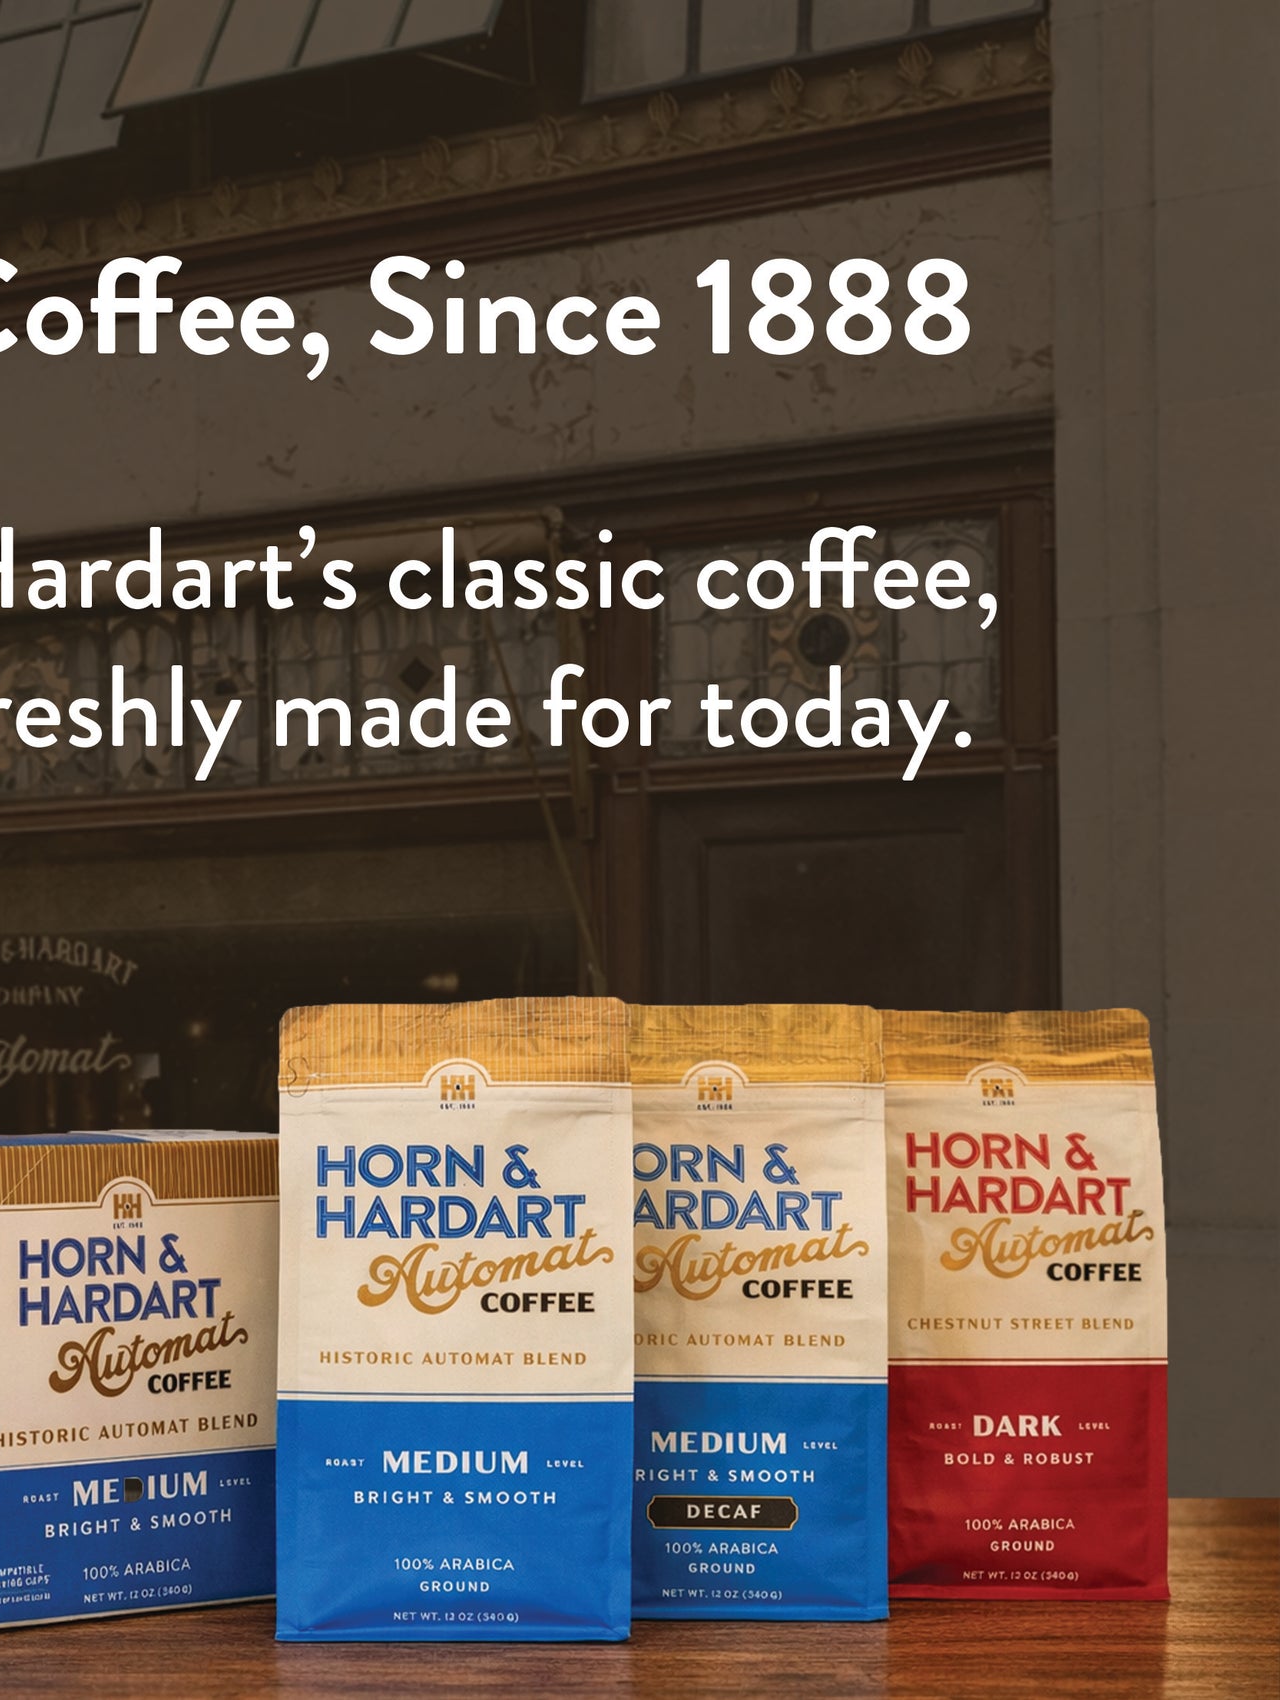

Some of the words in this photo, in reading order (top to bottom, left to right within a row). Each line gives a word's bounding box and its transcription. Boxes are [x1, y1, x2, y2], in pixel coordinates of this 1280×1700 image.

[906, 1132, 1050, 1170] HORN
[1065, 1132, 1098, 1171] &
[317, 1144, 484, 1187] HORN
[502, 1144, 541, 1188] &
[763, 1143, 800, 1185] &
[906, 1176, 1131, 1216] HARDART
[317, 1195, 585, 1239] HARDART
[940, 1209, 1154, 1279] Automat
[19, 1235, 145, 1279] HORN
[159, 1233, 188, 1273] &
[633, 1223, 869, 1301] Automat
[357, 1228, 614, 1315] Automat
[1047, 1263, 1141, 1282] COFFEE
[742, 1280, 853, 1299] COFFEE
[19, 1278, 221, 1326] HARDART
[481, 1292, 594, 1313] COFFEE
[907, 1318, 1003, 1330] CHESTNUT
[1011, 1318, 1073, 1330] STREET
[1082, 1319, 1134, 1330] BLEND
[687, 1334, 775, 1346] AUTOMAT
[784, 1335, 845, 1347] BLEND
[49, 1311, 248, 1397] Automat
[320, 1351, 413, 1365] HISTORIC
[422, 1352, 514, 1365] AUTOMAT
[523, 1353, 586, 1365] BLEND
[148, 1370, 231, 1394] COFFEE
[98, 1419, 189, 1440] AUTOMAT
[198, 1413, 258, 1432] BLEND
[973, 1415, 1062, 1437] DARK
[651, 1431, 787, 1454] MEDIUM
[383, 1451, 528, 1474] MEDIUM
[944, 1453, 995, 1465] BOLD
[1004, 1454, 1014, 1464] &
[1023, 1452, 1094, 1464] ROBUST
[635, 1469, 698, 1482] RIGHT
[707, 1470, 718, 1481] &
[729, 1471, 815, 1482] SMOOTH
[23, 1492, 59, 1504] ROAST
[73, 1470, 208, 1506] MEDIUM
[354, 1491, 432, 1504] BRIGHT
[443, 1492, 454, 1504] &
[465, 1492, 556, 1504] SMOOTH
[687, 1505, 761, 1519] DECAF
[45, 1519, 120, 1538] BRIGHT
[130, 1518, 141, 1531] &
[150, 1508, 232, 1529] SMOOTH
[965, 1519, 1003, 1530] 100%
[1008, 1519, 1075, 1530] ARABICA
[665, 1543, 703, 1554] 100%
[709, 1543, 778, 1554] ARABICA
[990, 1541, 1055, 1551] GROUND
[83, 1565, 119, 1581] 100%
[124, 1558, 191, 1576] ARABICA
[394, 1559, 434, 1571] 100%
[440, 1559, 514, 1571] ARABICA
[689, 1563, 755, 1574] GROUND
[963, 1571, 984, 1579] NET
[988, 1571, 1008, 1579] WT.
[84, 1593, 104, 1603] NET
[142, 1588, 154, 1598] OZ
[420, 1581, 490, 1592] GROUND
[662, 1589, 685, 1597] NET
[688, 1589, 708, 1598] WT.
[724, 1590, 739, 1598] OZ
[394, 1612, 416, 1620] NET
[421, 1612, 441, 1620] WT.
[458, 1612, 473, 1621] OZ
